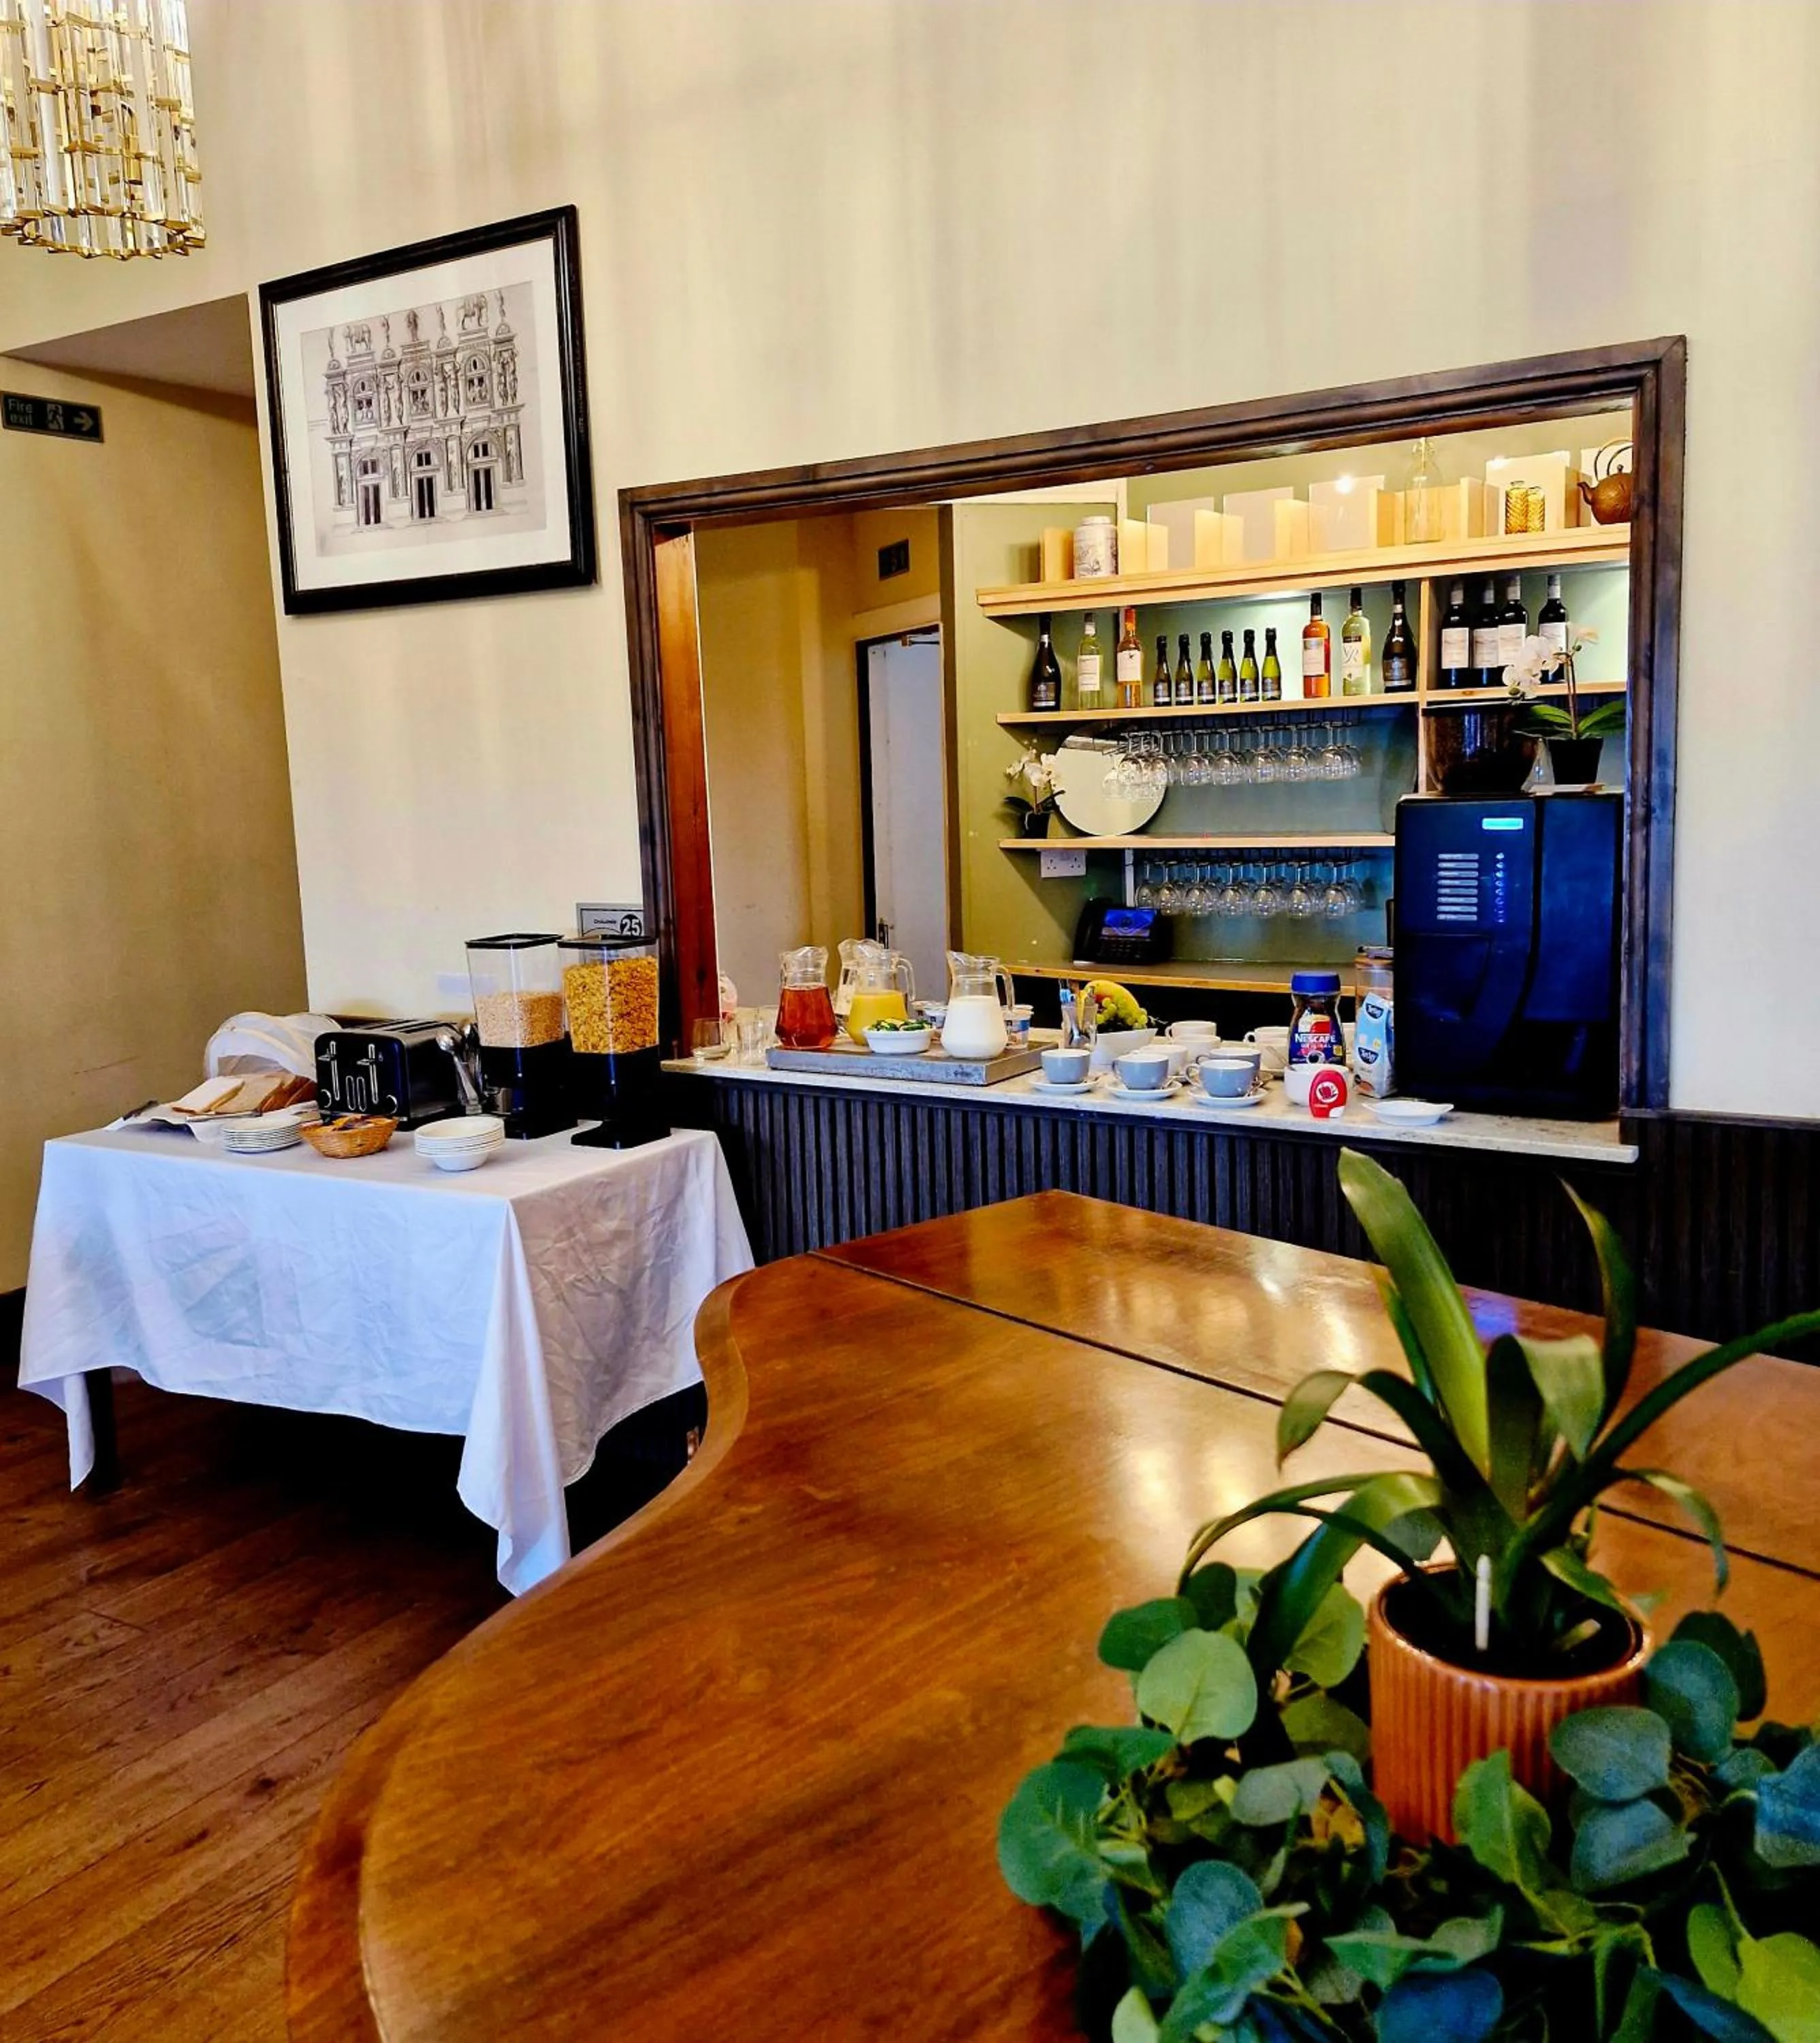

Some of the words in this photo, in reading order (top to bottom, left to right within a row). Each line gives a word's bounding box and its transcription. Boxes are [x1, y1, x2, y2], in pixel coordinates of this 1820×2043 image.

[7, 398, 33, 413] Fire
[10, 413, 33, 426] exit
[622, 917, 640, 936] 25
